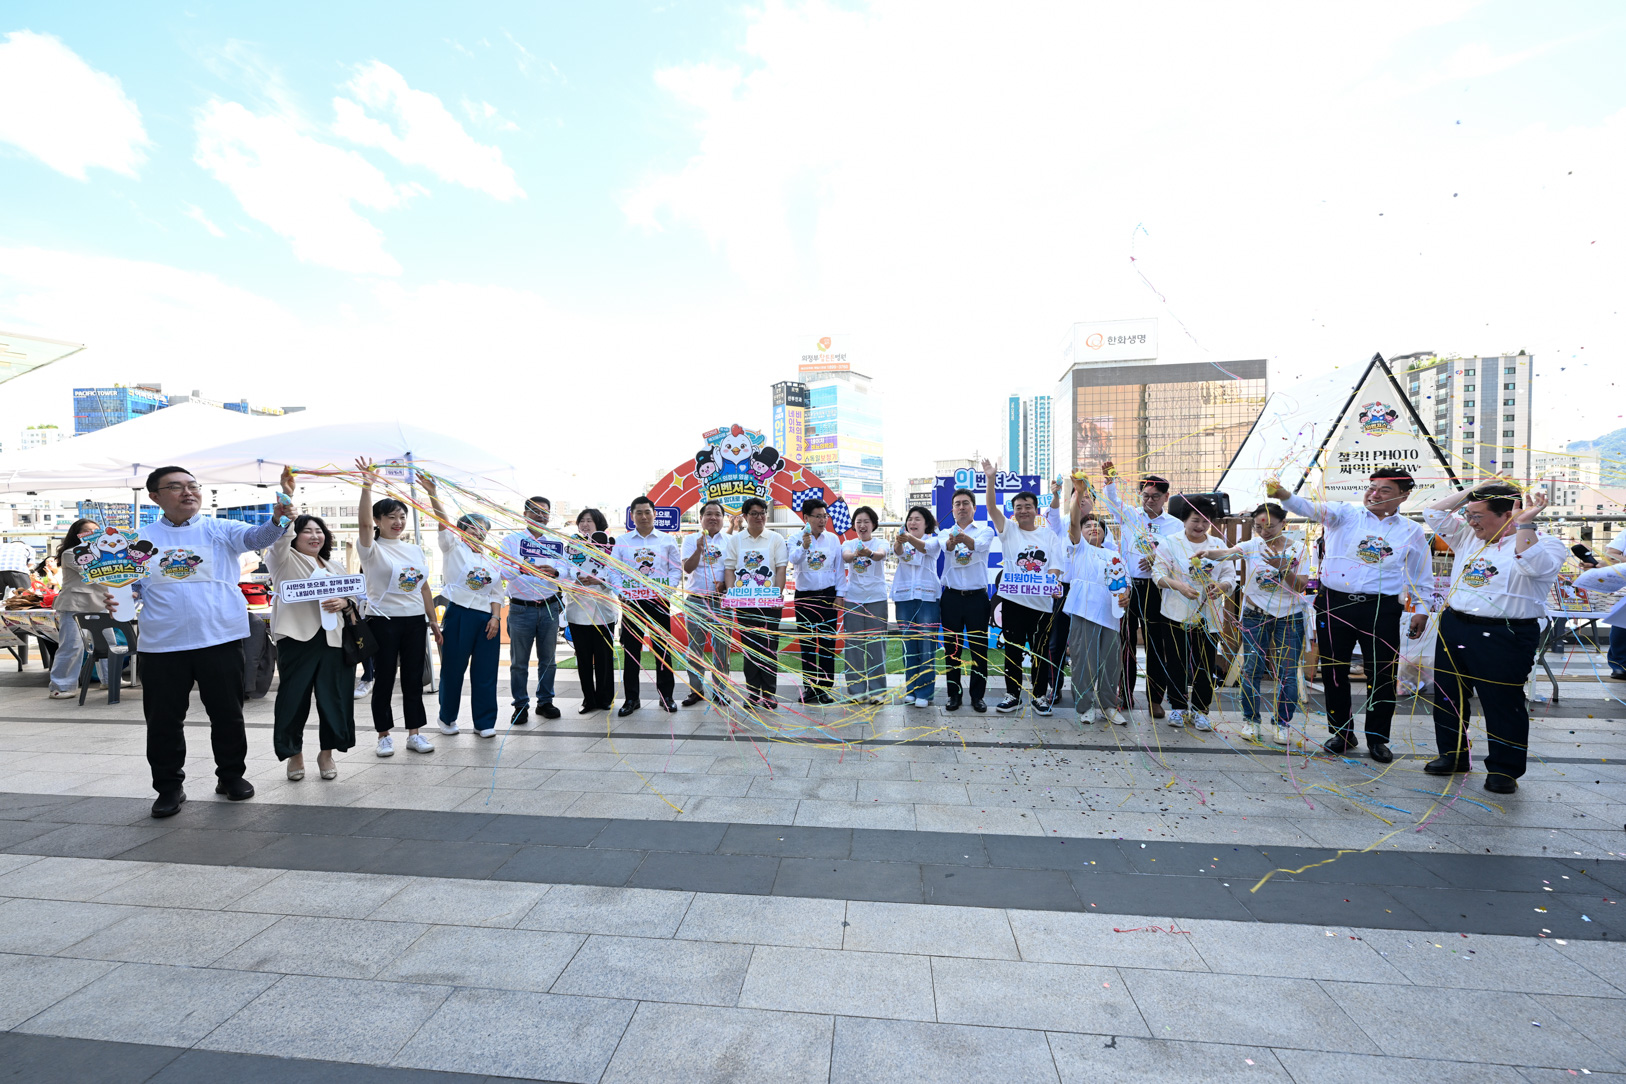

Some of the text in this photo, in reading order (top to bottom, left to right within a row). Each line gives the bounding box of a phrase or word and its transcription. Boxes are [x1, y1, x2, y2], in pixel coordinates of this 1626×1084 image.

[1107, 334, 1147, 345] 한화생명
[775, 419, 784, 451] 안과
[795, 411, 803, 452] 비뇨의학과
[1373, 449, 1418, 461] PHOTO
[709, 480, 766, 497] 의벤져스와
[90, 563, 144, 578] 의벤져스와
[1004, 572, 1058, 585] 퇴원하는 날,
[286, 583, 306, 591] 시민의
[296, 585, 354, 598] 내일이 든든한 의정부
[727, 587, 780, 597] 시민의 뜻으로
[999, 584, 1063, 595] 걱정 대신 안심
[758, 598, 784, 607] 의정부
